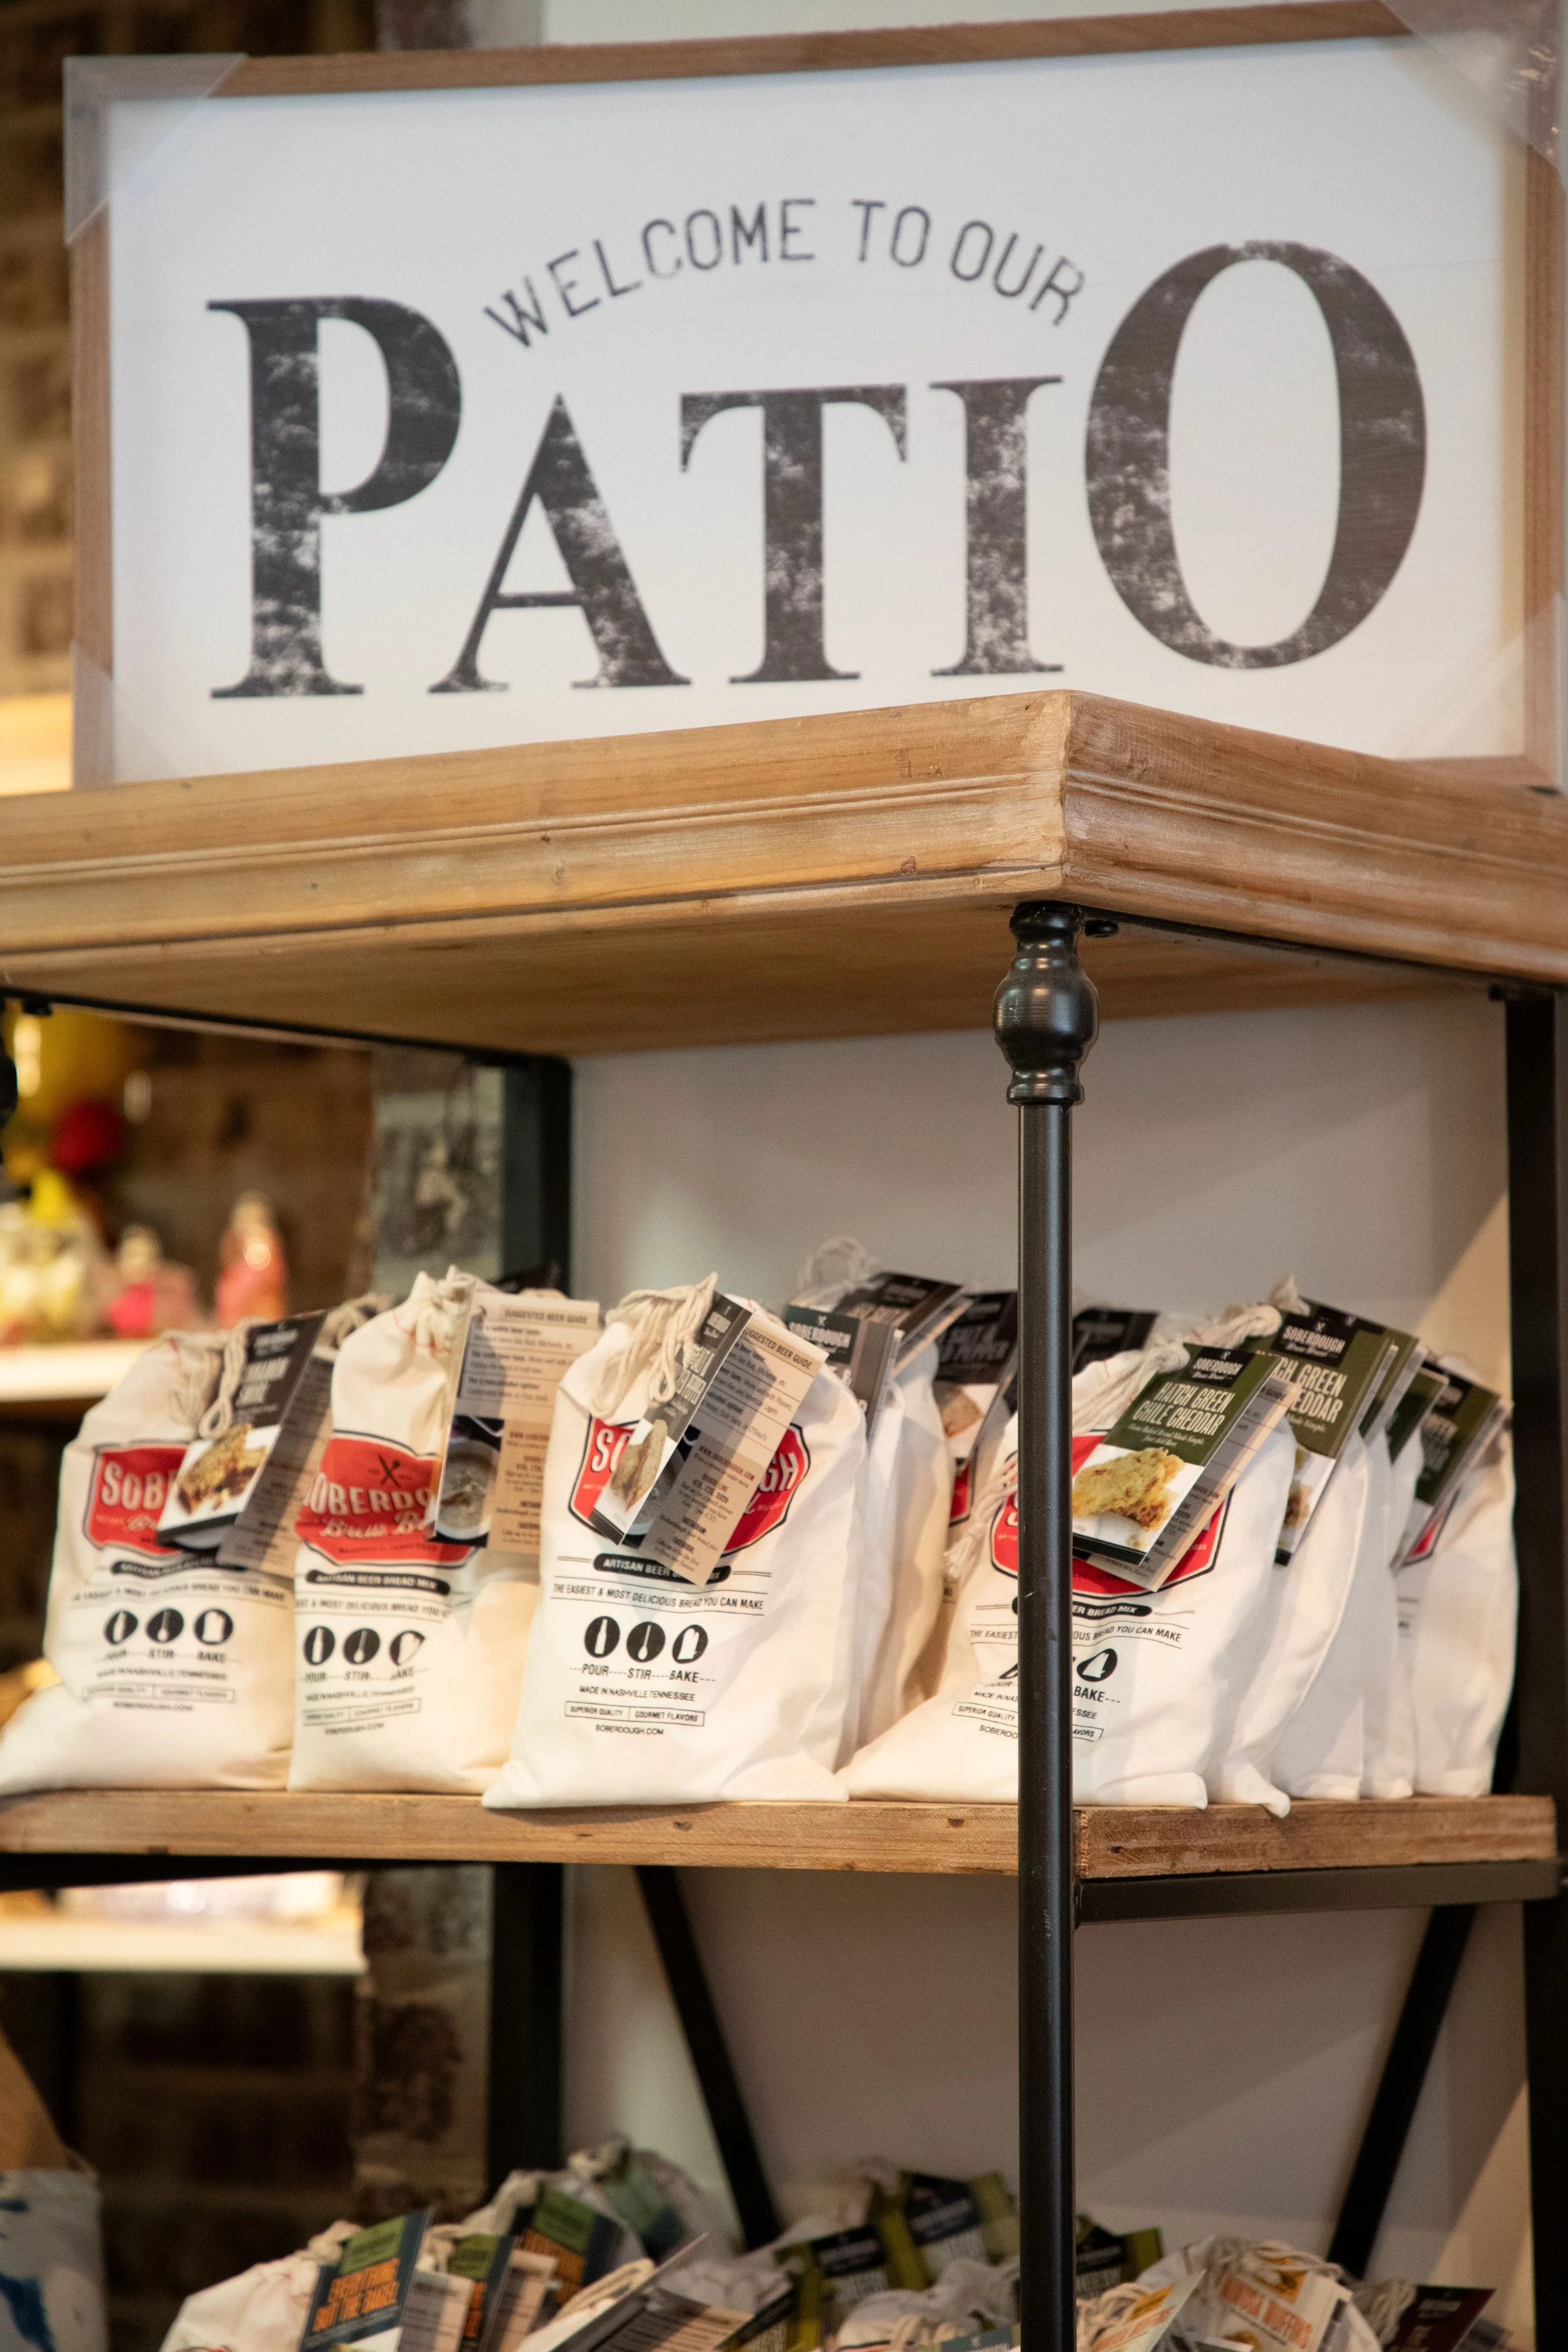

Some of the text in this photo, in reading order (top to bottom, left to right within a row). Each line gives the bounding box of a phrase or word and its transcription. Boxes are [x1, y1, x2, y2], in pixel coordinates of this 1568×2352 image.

[483, 198, 1085, 348] WELCOME TO OUR
[207, 239, 1428, 699] PATIO
[742, 1326, 813, 1370] UGGESTED BEER GUIDE
[1282, 1325, 1347, 1354] SOBERDOUGH
[1192, 1357, 1244, 1375] SOBERDOUGH
[1273, 1357, 1348, 1398] CH GREEN
[1153, 1381, 1236, 1414] HATCH GREEN
[1131, 1399, 1226, 1437] CHILE CHEDDAR
[603, 1558, 671, 1577] ARTISAN BEER
[345, 1599, 388, 1611] DELICIOUS
[553, 1583, 765, 1610] THE EASIEST & MOST DELICIOUS BREAD YOU CAN MAKE
[1073, 1605, 1138, 1617] ER BREAD MIX
[970, 1630, 983, 1638] THE
[985, 1630, 1018, 1640] EASIEST
[1093, 1626, 1115, 1640] BREAD
[1116, 1626, 1135, 1634] YOU
[1136, 1627, 1154, 1635] CAN
[1155, 1629, 1182, 1643] MAKE
[147, 1648, 175, 1660] STIR
[344, 1671, 370, 1682] STIR
[581, 1663, 700, 1683] POUR STIR BAKE
[579, 1685, 599, 1695] MADE
[608, 1687, 648, 1698] NASHVILLE
[649, 1690, 696, 1702] TENNESSEE
[974, 1691, 993, 1699] MADE
[1004, 1695, 1018, 1703] NAS
[1073, 1685, 1106, 1702] BAKE
[570, 1705, 623, 1717] SUPERIOR QUALITY
[635, 1710, 699, 1723] GOURMET FLAVORS
[595, 1724, 664, 1735] SOBERDOUGH.COM
[958, 1705, 1096, 1737] SUPERIOR QUALITY AVORS
[978, 1724, 1018, 1739] SOBERDO
